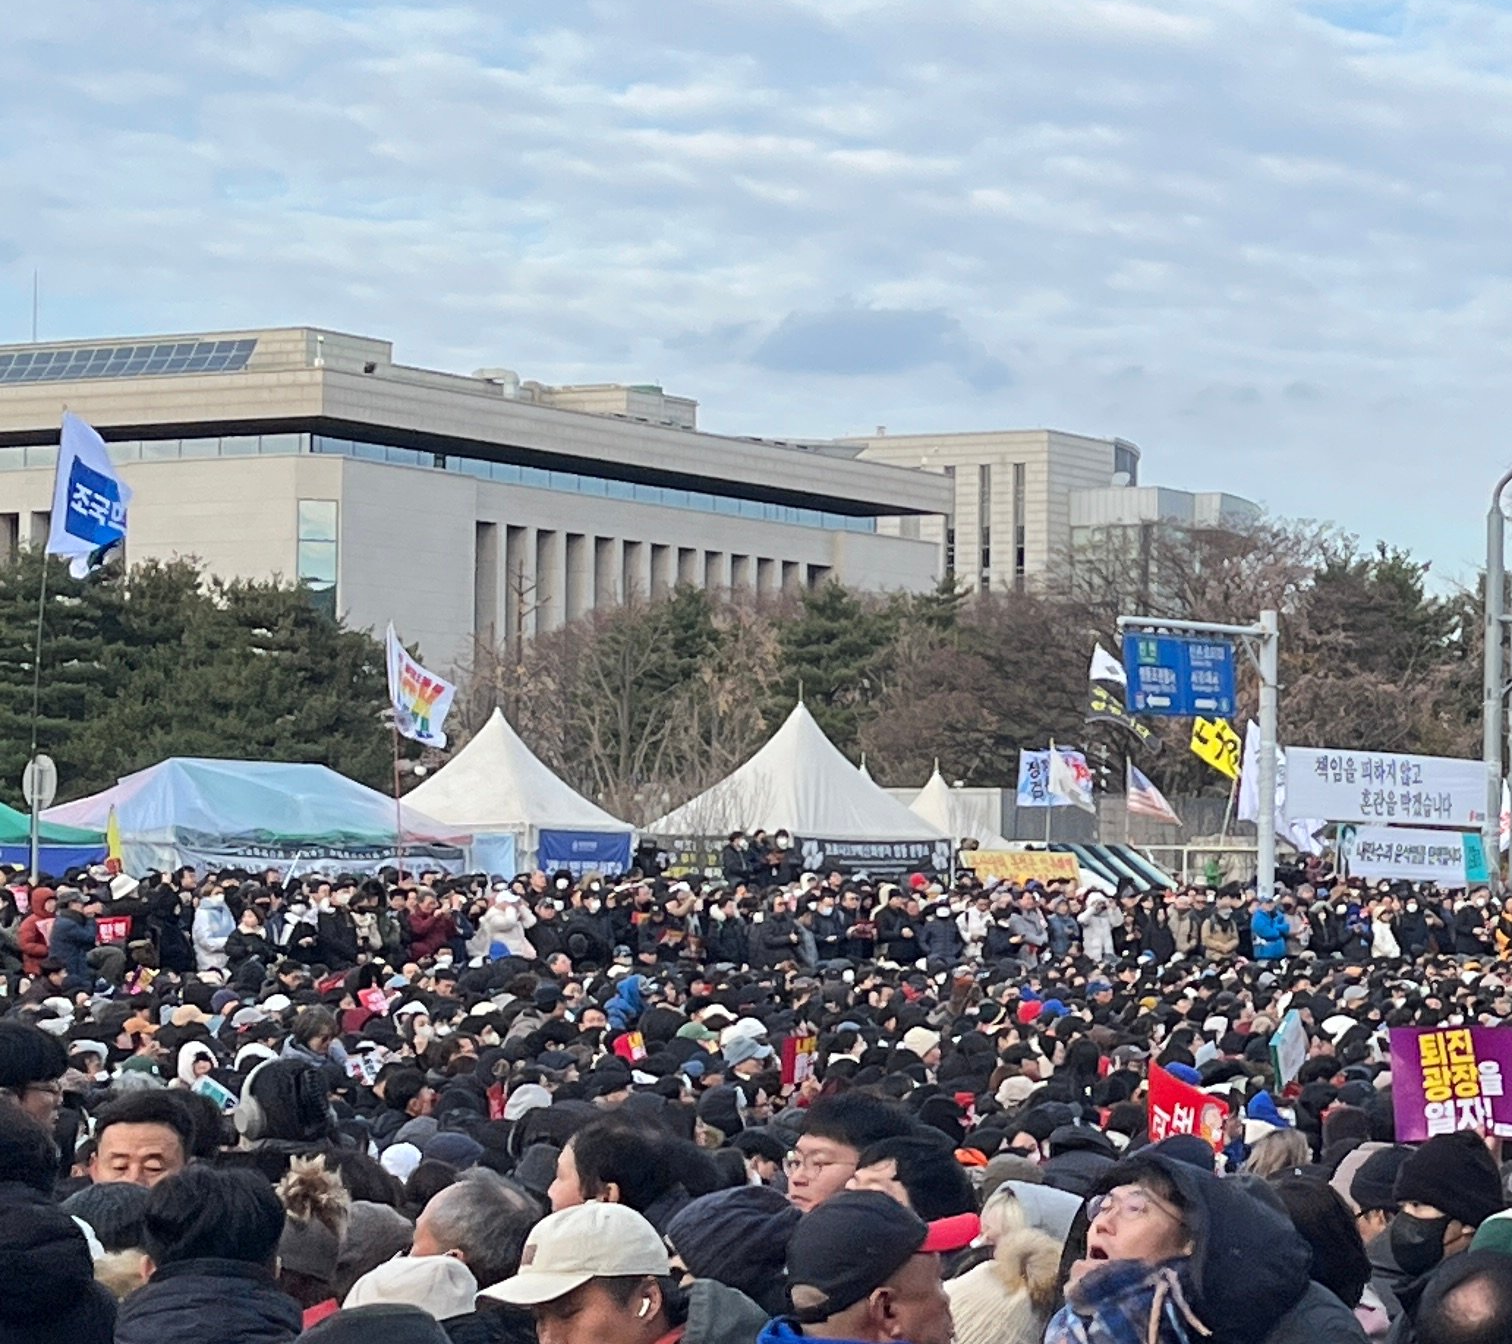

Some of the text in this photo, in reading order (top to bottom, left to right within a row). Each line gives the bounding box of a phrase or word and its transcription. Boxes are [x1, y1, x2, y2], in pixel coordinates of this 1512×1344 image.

[1315, 755, 1423, 786] 책임을 피하지 않고
[1360, 788, 1398, 816] 혼란을
[1400, 792, 1452, 819] 막겠습니다
[1418, 1028, 1476, 1067] 퇴진
[1422, 1060, 1504, 1102] 광장을
[1424, 1096, 1494, 1138] 열자!
